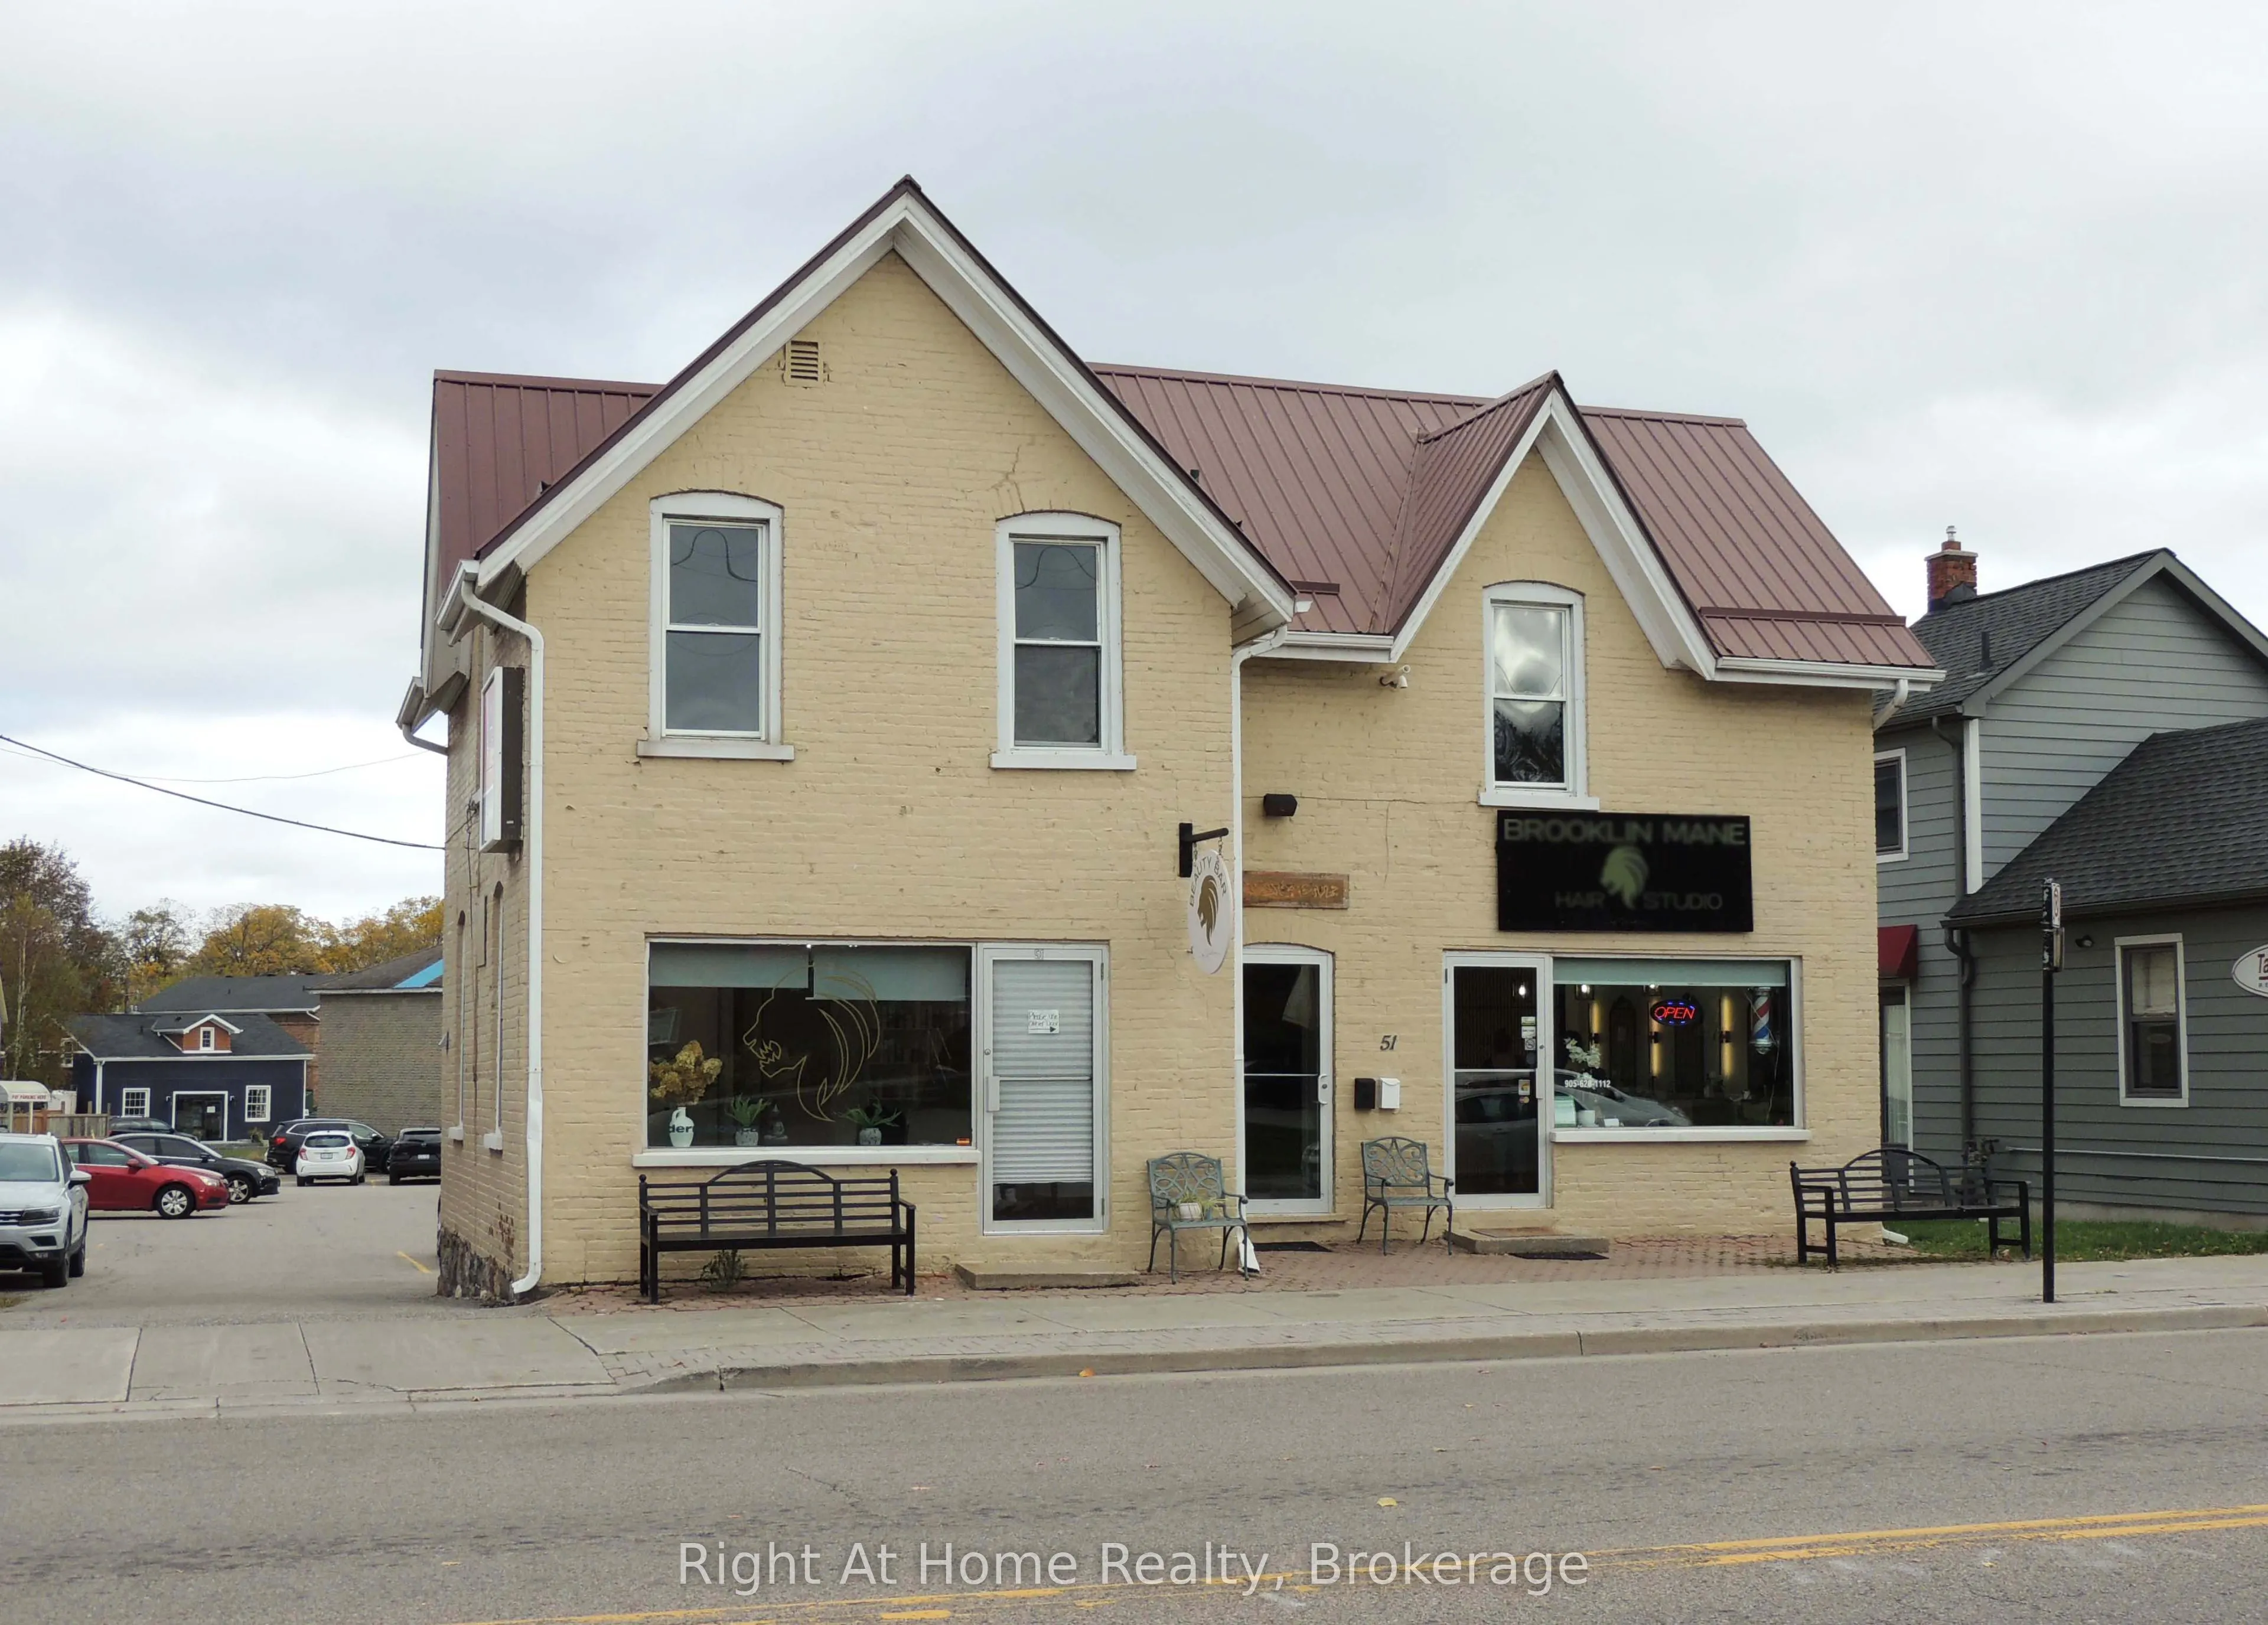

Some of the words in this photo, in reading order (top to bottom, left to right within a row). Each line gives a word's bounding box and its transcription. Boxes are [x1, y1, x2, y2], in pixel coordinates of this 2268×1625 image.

[1504, 818, 1653, 843] BROOKLIN
[1663, 821, 1746, 845] MANE
[1190, 856, 1211, 906] BEAUTY
[1214, 862, 1227, 897] BAR
[1556, 891, 1605, 909] HAIR
[1644, 892, 1723, 910] STUDIO
[1654, 1006, 1695, 1019] OPEN
[1380, 1035, 1397, 1050] 51
